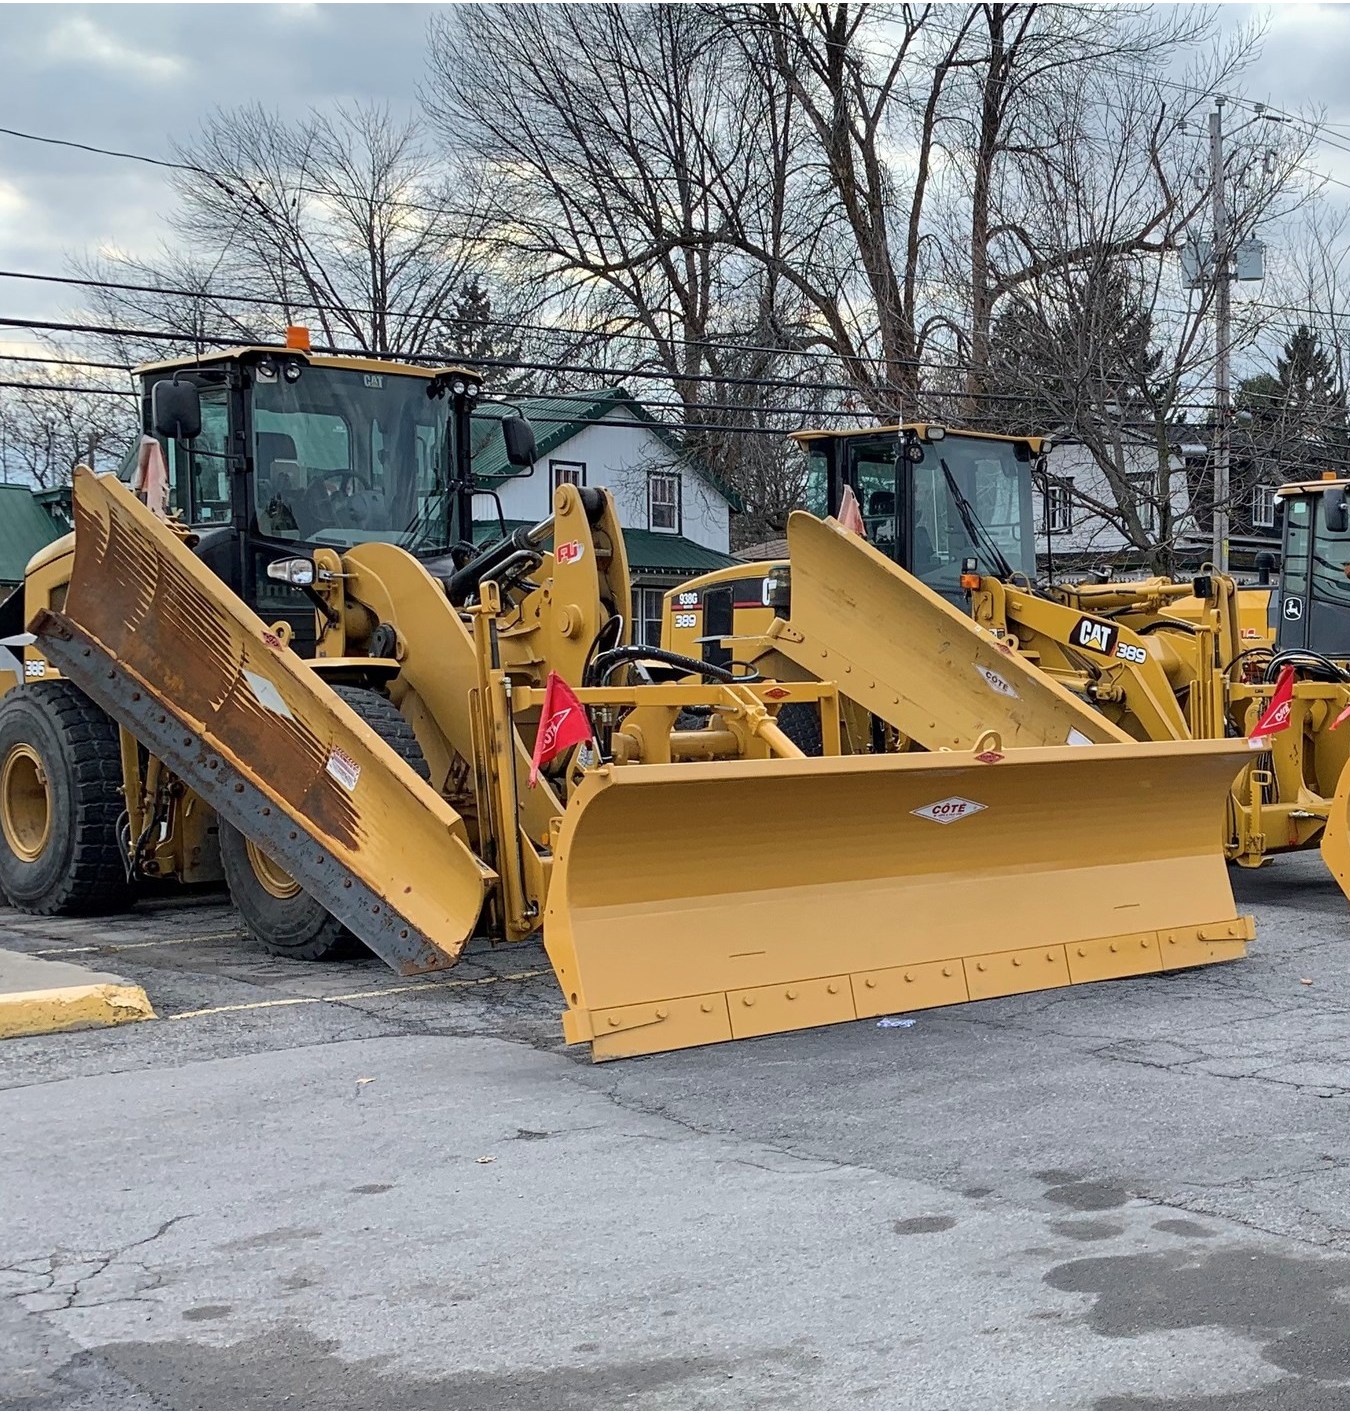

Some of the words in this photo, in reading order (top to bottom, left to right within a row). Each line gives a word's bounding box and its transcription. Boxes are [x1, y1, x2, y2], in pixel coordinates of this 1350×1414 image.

[363, 374, 384, 388] CAT
[675, 614, 697, 628] 389
[1079, 619, 1112, 652] CAT
[1116, 642, 1147, 664] 389
[932, 803, 968, 815] CÔTÉ
